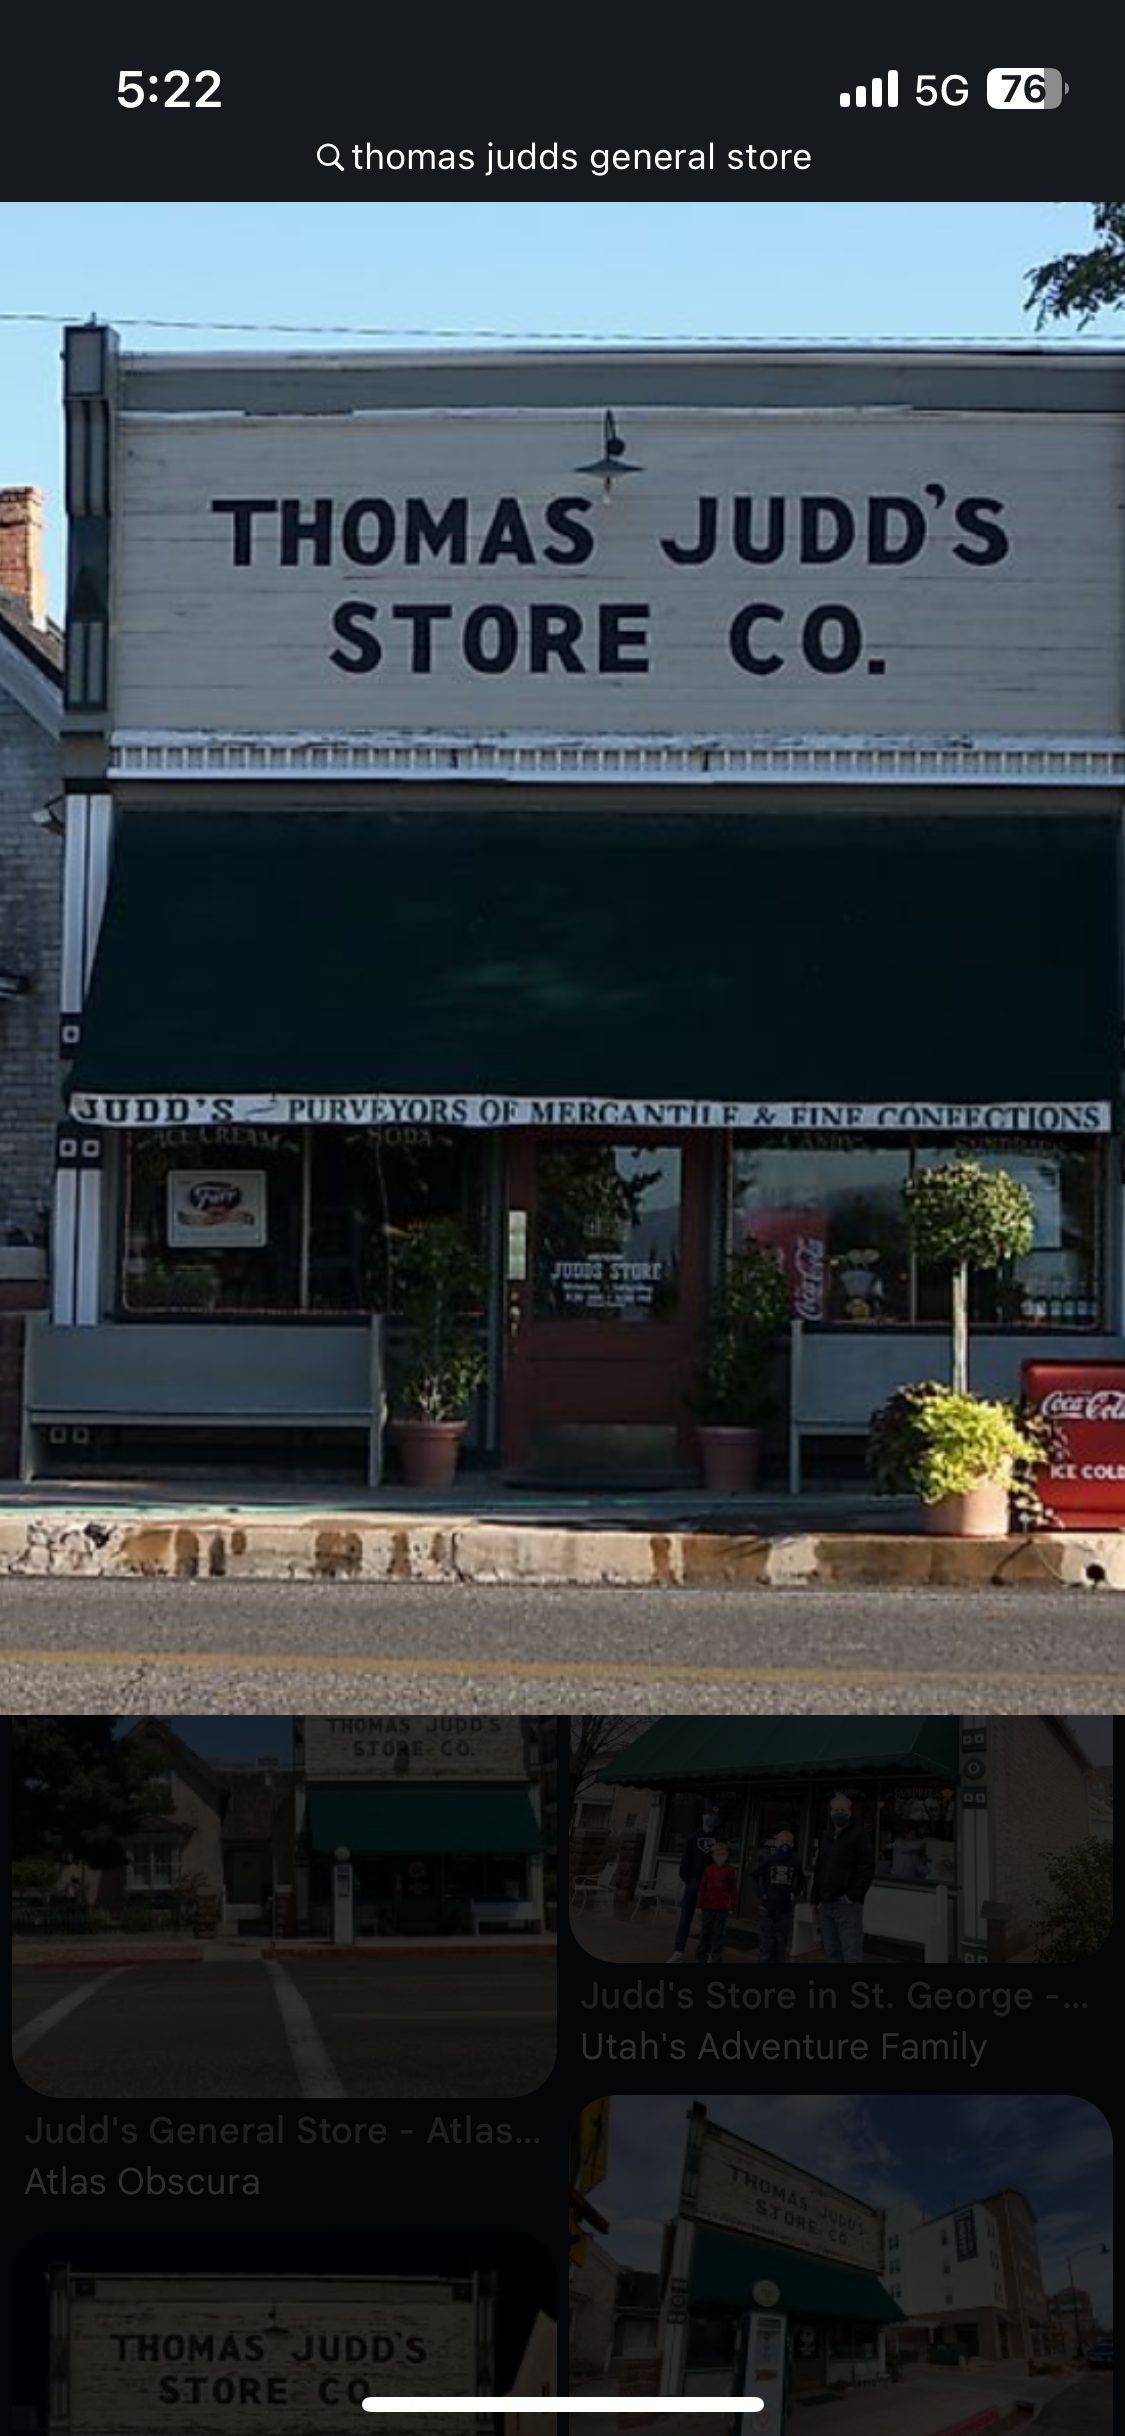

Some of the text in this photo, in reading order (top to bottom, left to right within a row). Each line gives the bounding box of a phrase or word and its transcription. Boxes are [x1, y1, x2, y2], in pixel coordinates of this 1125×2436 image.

[118, 70, 221, 108] 5:22
[916, 75, 968, 106] 5G
[1002, 74, 1046, 104] 76
[352, 142, 811, 176] thomas judds general store
[211, 484, 1010, 567] THOMAS JUDD'S
[329, 601, 886, 676] STORE CO.
[78, 1098, 1102, 1130] JUDD'S PURVEYORS OF MERCANTILE & FINE CONFECTIONS
[366, 1129, 432, 1147] SODA
[608, 1262, 662, 1281] STORE
[1051, 1465, 1078, 1479] ICE
[325, 1715, 503, 1734] THOMAS JUDD'S
[353, 1740, 476, 1757] STORE CO.
[581, 1980, 693, 2009] Judd's
[707, 1982, 795, 2009] Store
[809, 1980, 836, 2008] in
[851, 1982, 893, 2009] St.
[908, 1982, 1032, 2017] George
[582, 2031, 987, 2067] Utah's Adventure Family
[25, 2115, 137, 2144] Judd's
[150, 2115, 283, 2144] General
[298, 2117, 386, 2144] Store
[25, 2166, 259, 2195] Atlas Obscura
[727, 2164, 809, 2212] THOMAS
[755, 2199, 819, 2235] STORE
[109, 2331, 428, 2364] THOMAS JUDD'S
[159, 2376, 288, 2405] STORE
